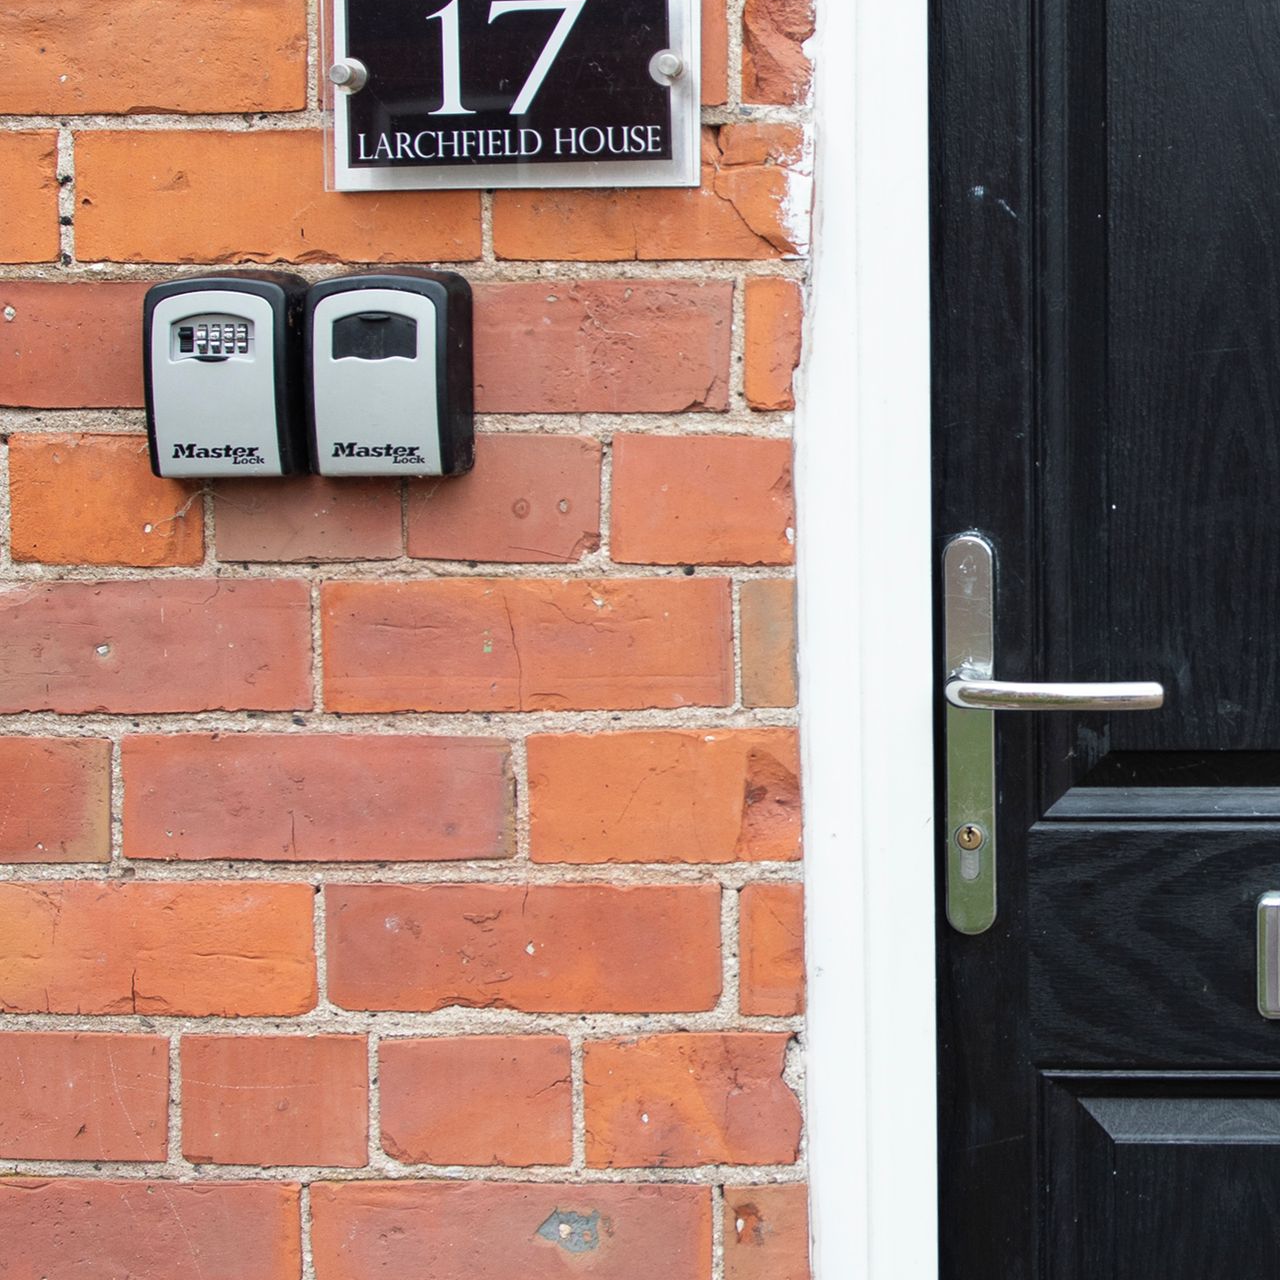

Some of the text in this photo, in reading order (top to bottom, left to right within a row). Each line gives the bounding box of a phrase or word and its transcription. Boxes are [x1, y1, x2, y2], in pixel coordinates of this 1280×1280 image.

[358, 125, 662, 160] LARCHFIELD HOUSE
[172, 443, 259, 459] Master
[332, 442, 420, 458] Master
[232, 456, 265, 465] Lock
[392, 454, 425, 464] Lock
